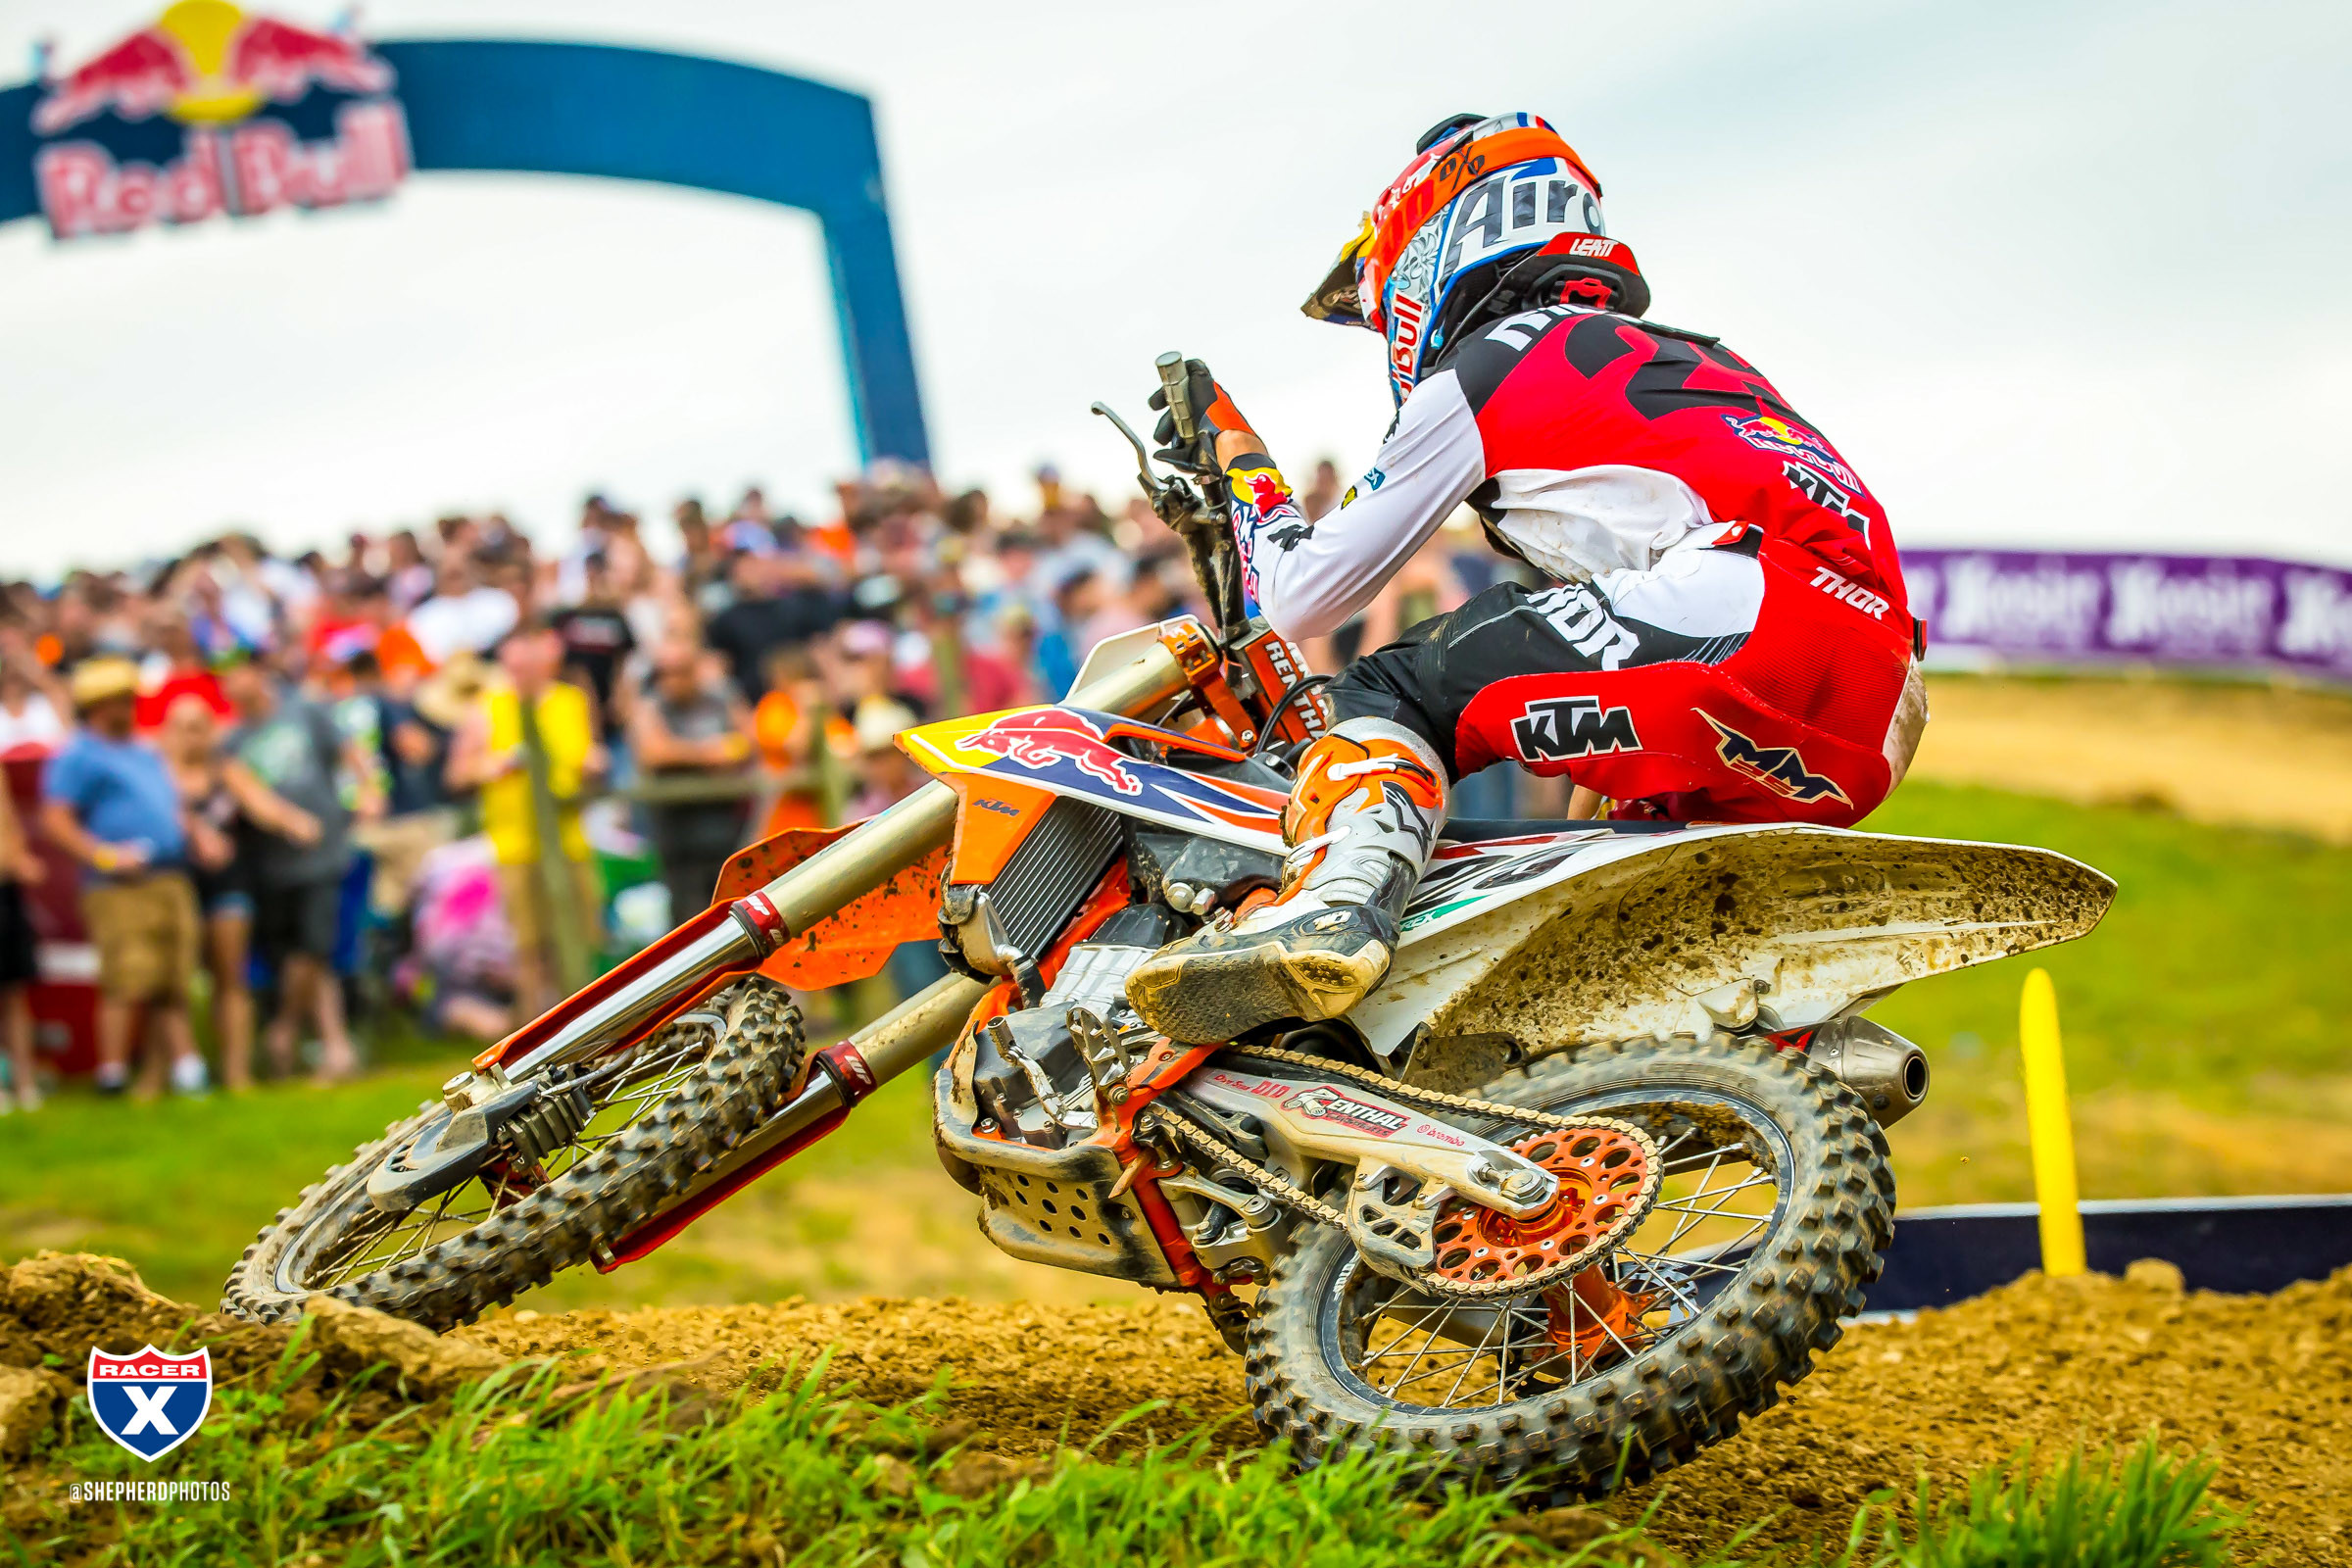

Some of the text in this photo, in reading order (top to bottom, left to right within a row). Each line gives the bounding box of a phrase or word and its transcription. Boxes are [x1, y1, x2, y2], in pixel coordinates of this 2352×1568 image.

[39, 99, 412, 239] Red Bull
[1569, 237, 1620, 258] LEATT
[1809, 565, 1890, 620] THOR
[1510, 695, 1643, 762] KTM
[972, 798, 1020, 816] KTM
[1282, 1087, 1407, 1130] RENTHAL
[1427, 1127, 1466, 1148] brembo
